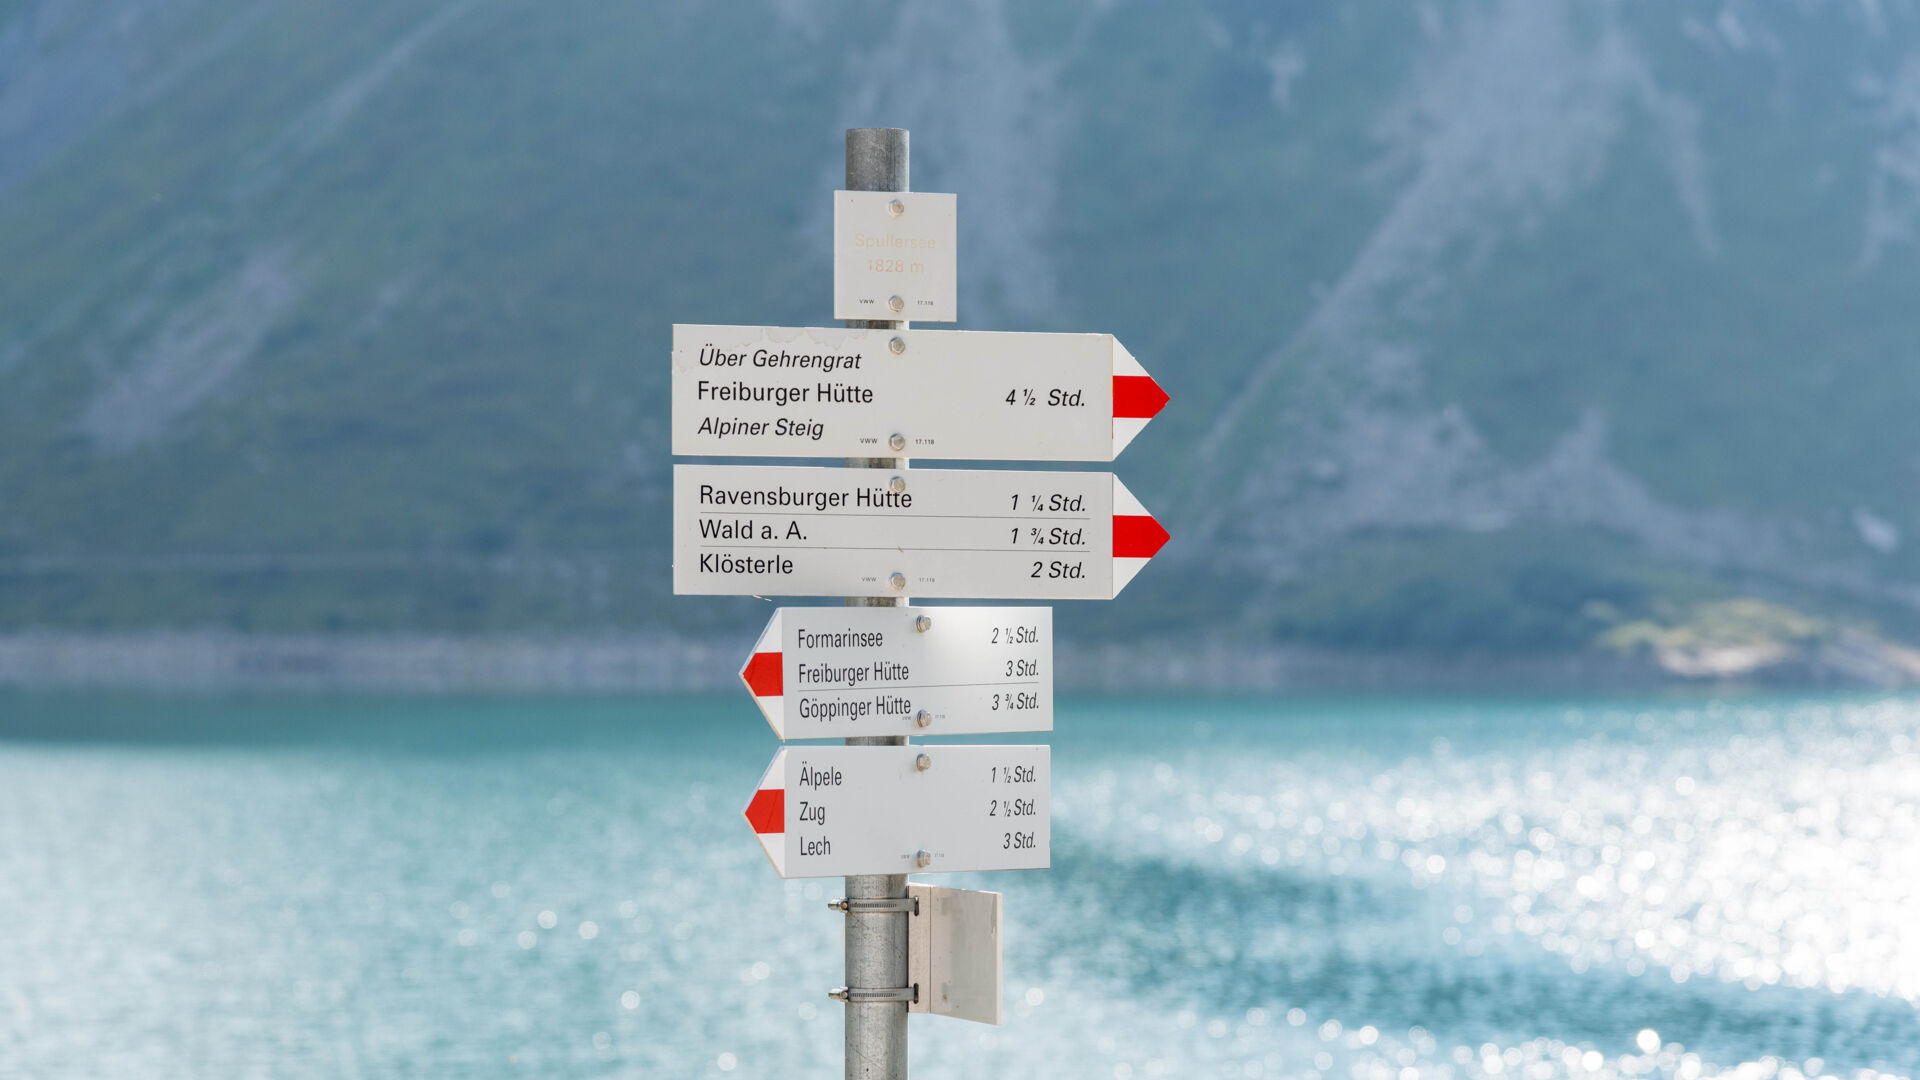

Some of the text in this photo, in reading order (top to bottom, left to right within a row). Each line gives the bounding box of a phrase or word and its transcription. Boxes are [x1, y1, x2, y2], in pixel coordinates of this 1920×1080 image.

[867, 259, 925, 273] 1828 m
[700, 343, 862, 372] Über Gehrengrat
[699, 381, 873, 406] Freiburger Hütte
[1005, 389, 1016, 405] 4
[1048, 389, 1084, 406] Std.
[697, 417, 824, 440] Alpiner Steig
[701, 485, 912, 511] Ravensburger Hütte
[1012, 494, 1018, 510] 1
[1049, 494, 1085, 512] Std.
[699, 519, 806, 540] Wald a. A.
[1012, 528, 1018, 544] 1
[1049, 528, 1085, 545] Std.
[701, 553, 793, 574] Klösterle
[1031, 561, 1085, 578] 2 Std.
[798, 628, 883, 648] Formarinsee
[992, 628, 999, 644] 2
[1016, 626, 1038, 643] Std.
[799, 661, 909, 686] Freiburger Hütte
[1006, 659, 1038, 677] 3 Std.
[800, 696, 911, 721] Göppinger Hütte
[992, 694, 999, 710] 3
[1017, 692, 1038, 709] Std.
[800, 761, 842, 791] Älpele
[992, 767, 996, 783] 1
[1014, 766, 1036, 782] Std.
[800, 801, 825, 825] Zug
[990, 800, 997, 816] 2
[1014, 799, 1035, 816] Std.
[801, 836, 830, 856] Lech
[1003, 832, 1035, 849] 3 Std.
